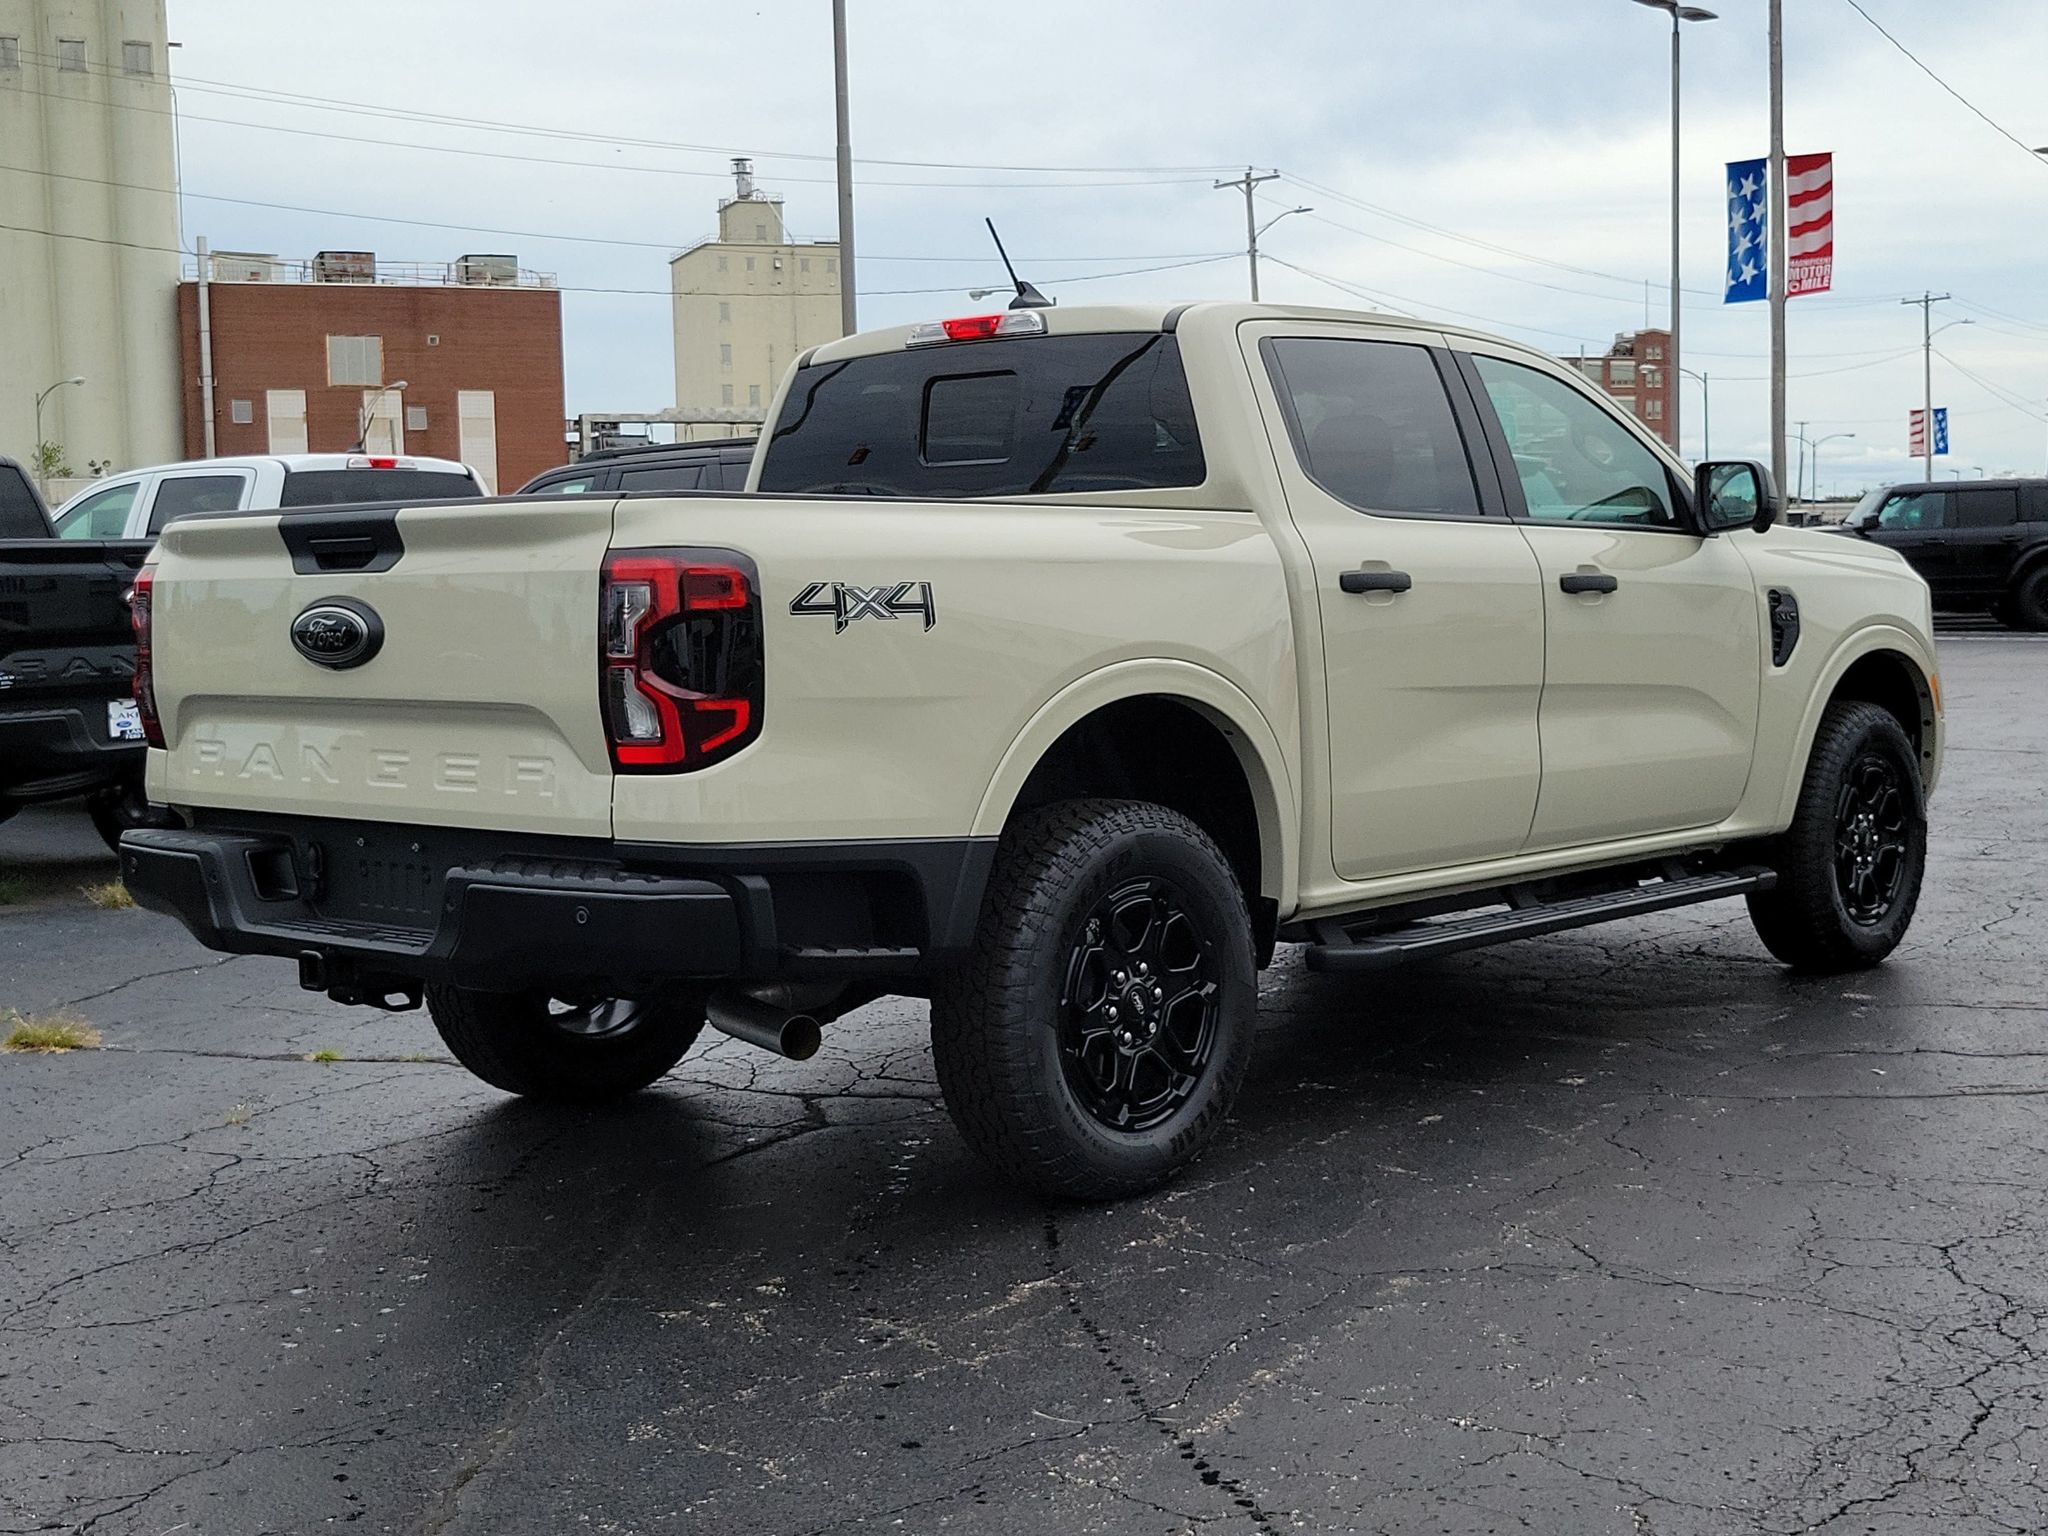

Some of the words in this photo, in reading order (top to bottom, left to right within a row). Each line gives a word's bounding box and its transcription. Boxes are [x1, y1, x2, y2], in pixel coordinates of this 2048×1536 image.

[1789, 264, 1831, 280] MOTOR
[1801, 276, 1830, 290] MILE
[306, 618, 347, 648] Ford
[191, 739, 556, 798] RANGER
